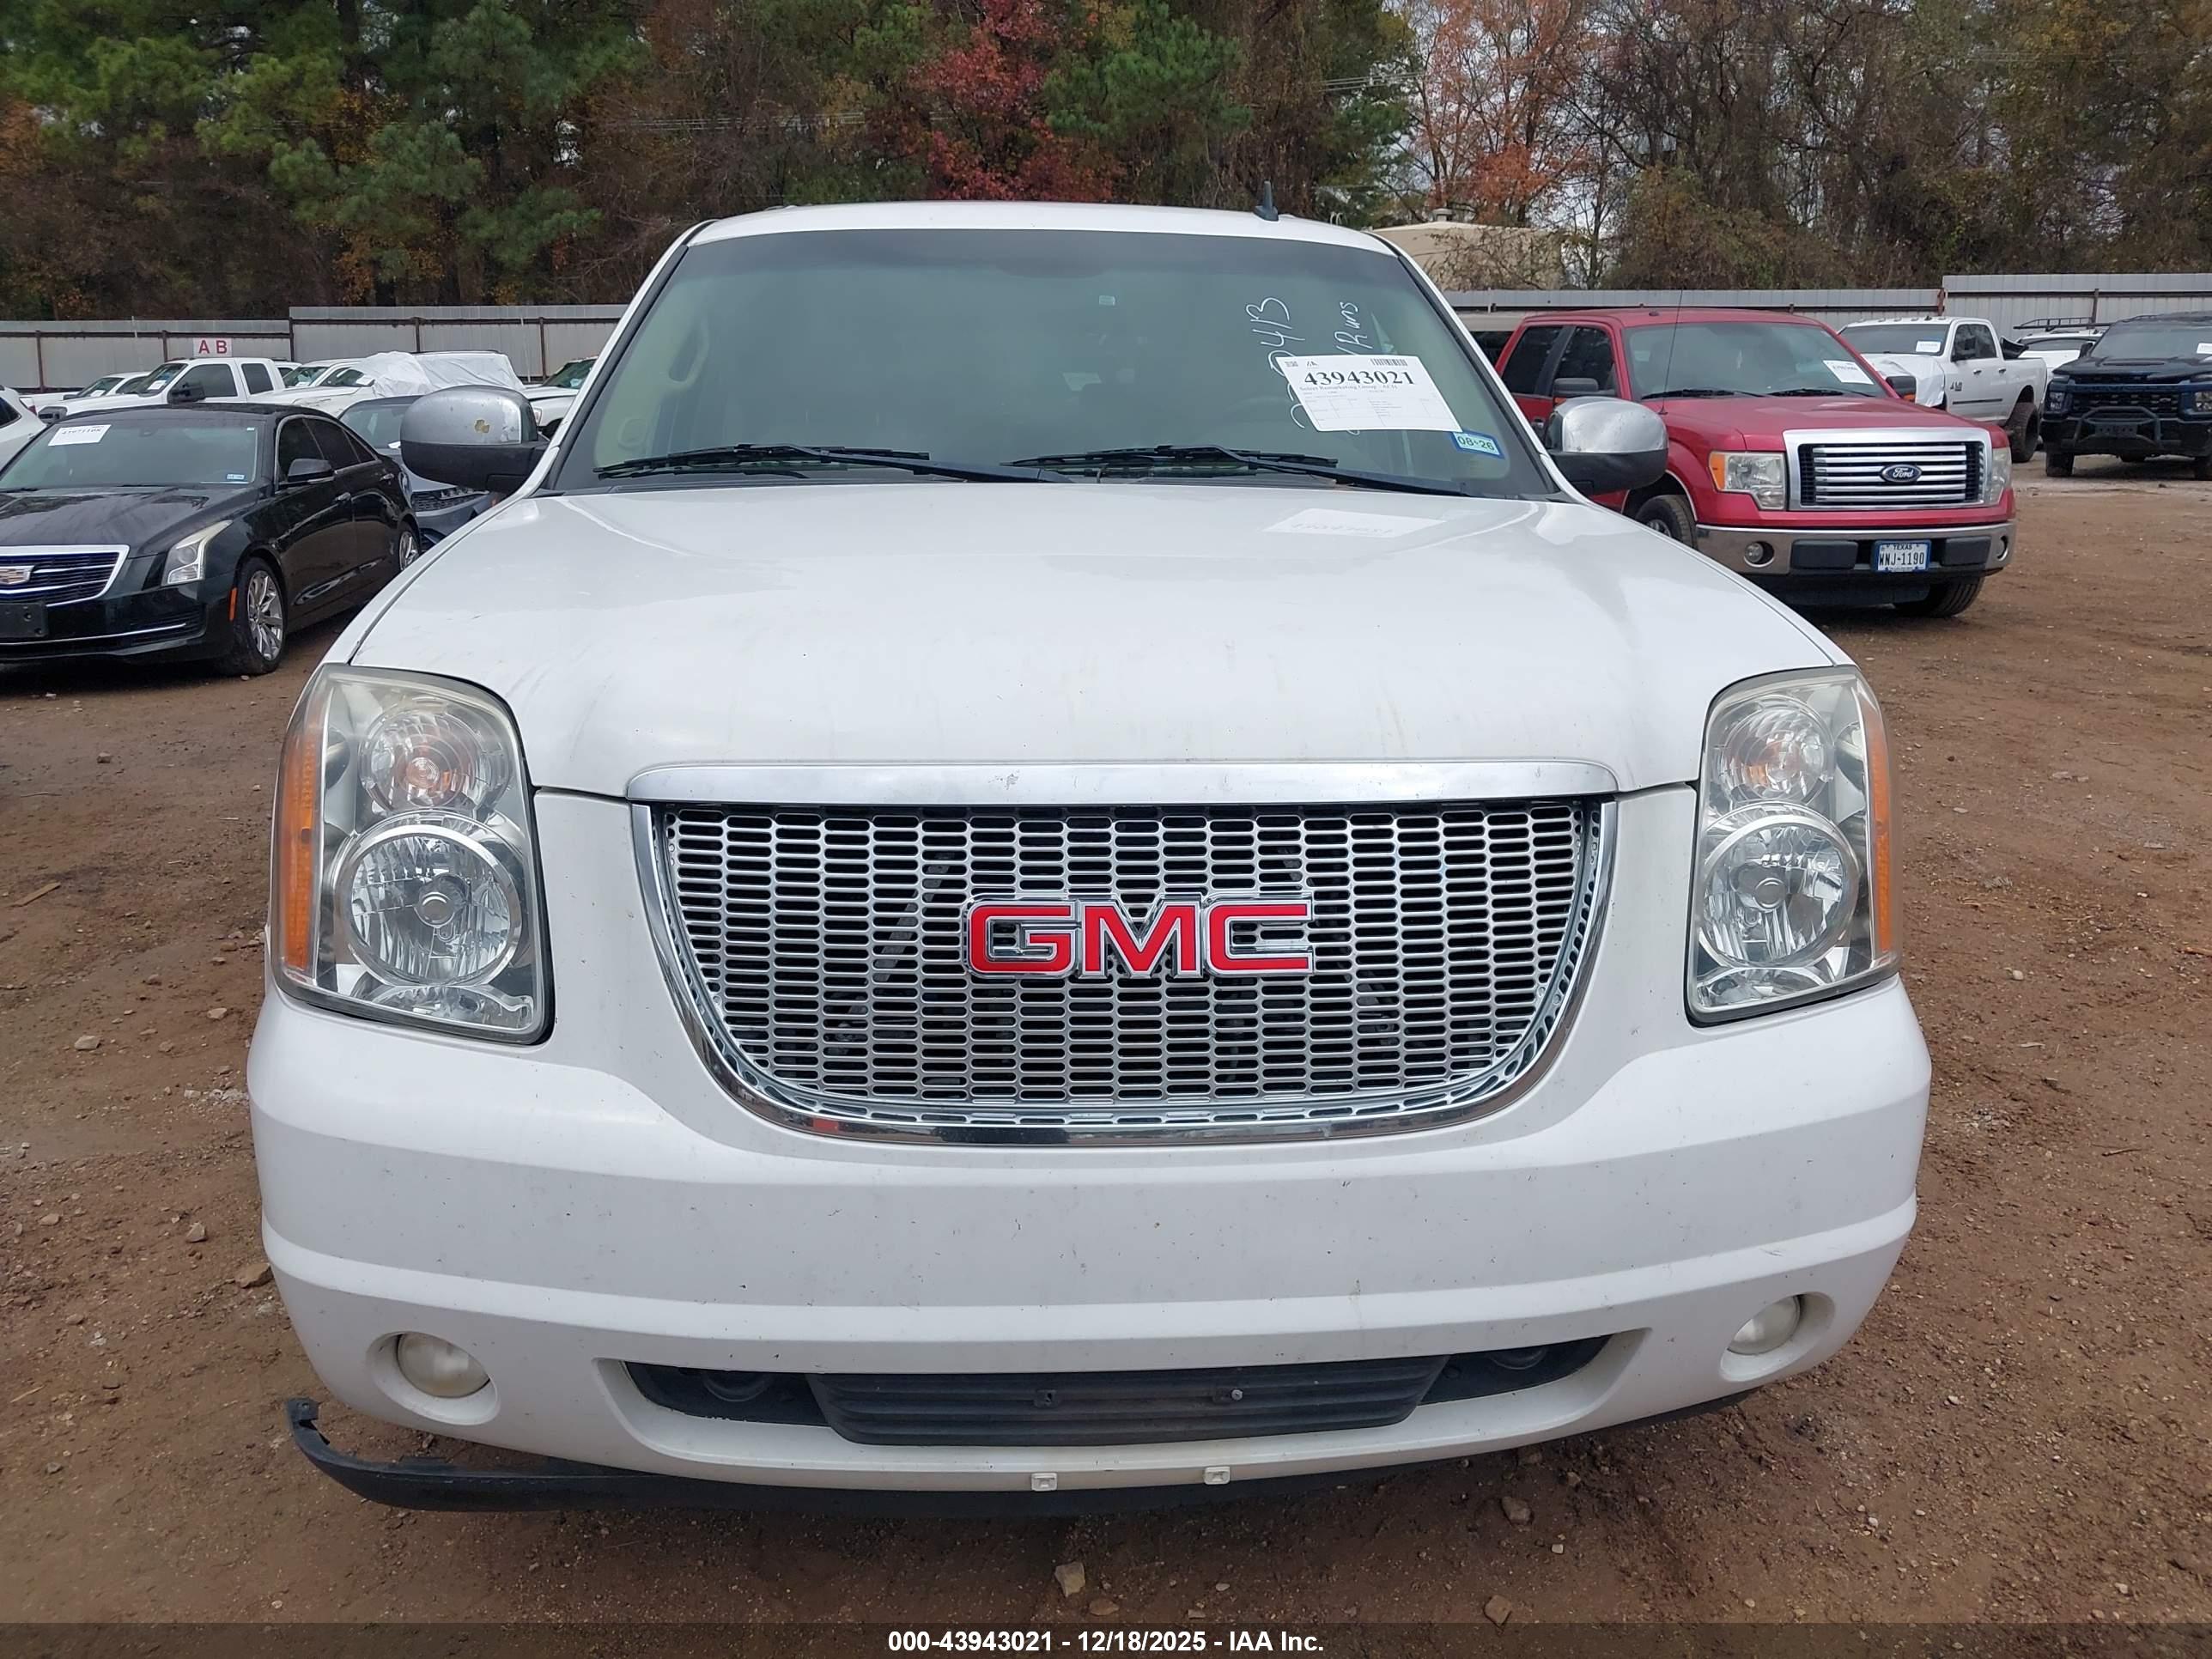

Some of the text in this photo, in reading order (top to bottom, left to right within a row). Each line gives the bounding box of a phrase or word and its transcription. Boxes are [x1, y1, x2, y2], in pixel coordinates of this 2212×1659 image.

[198, 340, 228, 354] A B
[1304, 371, 1415, 386] 43943021
[1892, 467, 1914, 478] Ford
[966, 894, 1315, 979] GMC
